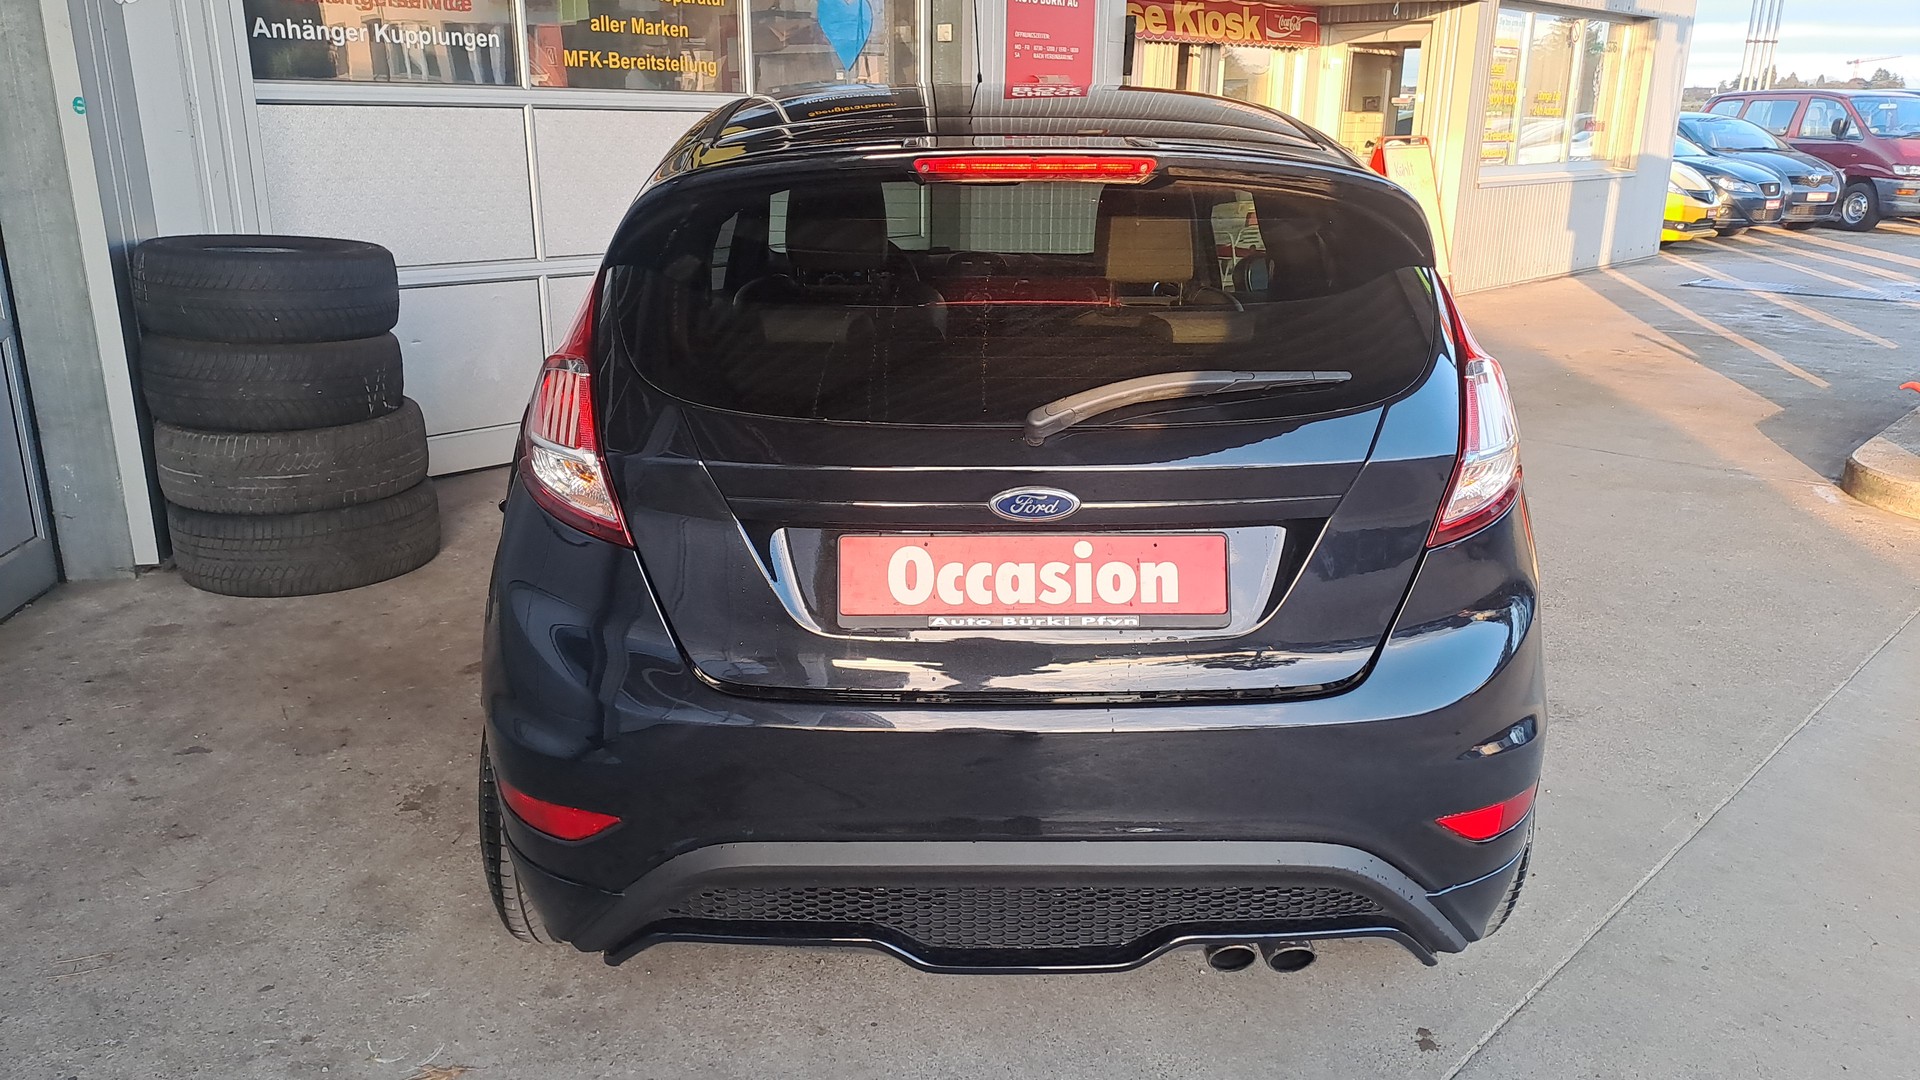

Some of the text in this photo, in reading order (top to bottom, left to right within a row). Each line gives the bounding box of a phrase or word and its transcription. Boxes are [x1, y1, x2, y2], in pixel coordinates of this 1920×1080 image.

[252, 17, 500, 51] Anhänger Kupplungen
[590, 15, 689, 38] aller Marken
[1173, 0, 1262, 41] Kiosk
[563, 50, 717, 77] MFK-Bereitstellung
[1010, 494, 1060, 514] Ford
[887, 540, 1180, 606] Occasion
[930, 615, 1138, 627] Auto Bürki Pfyn
